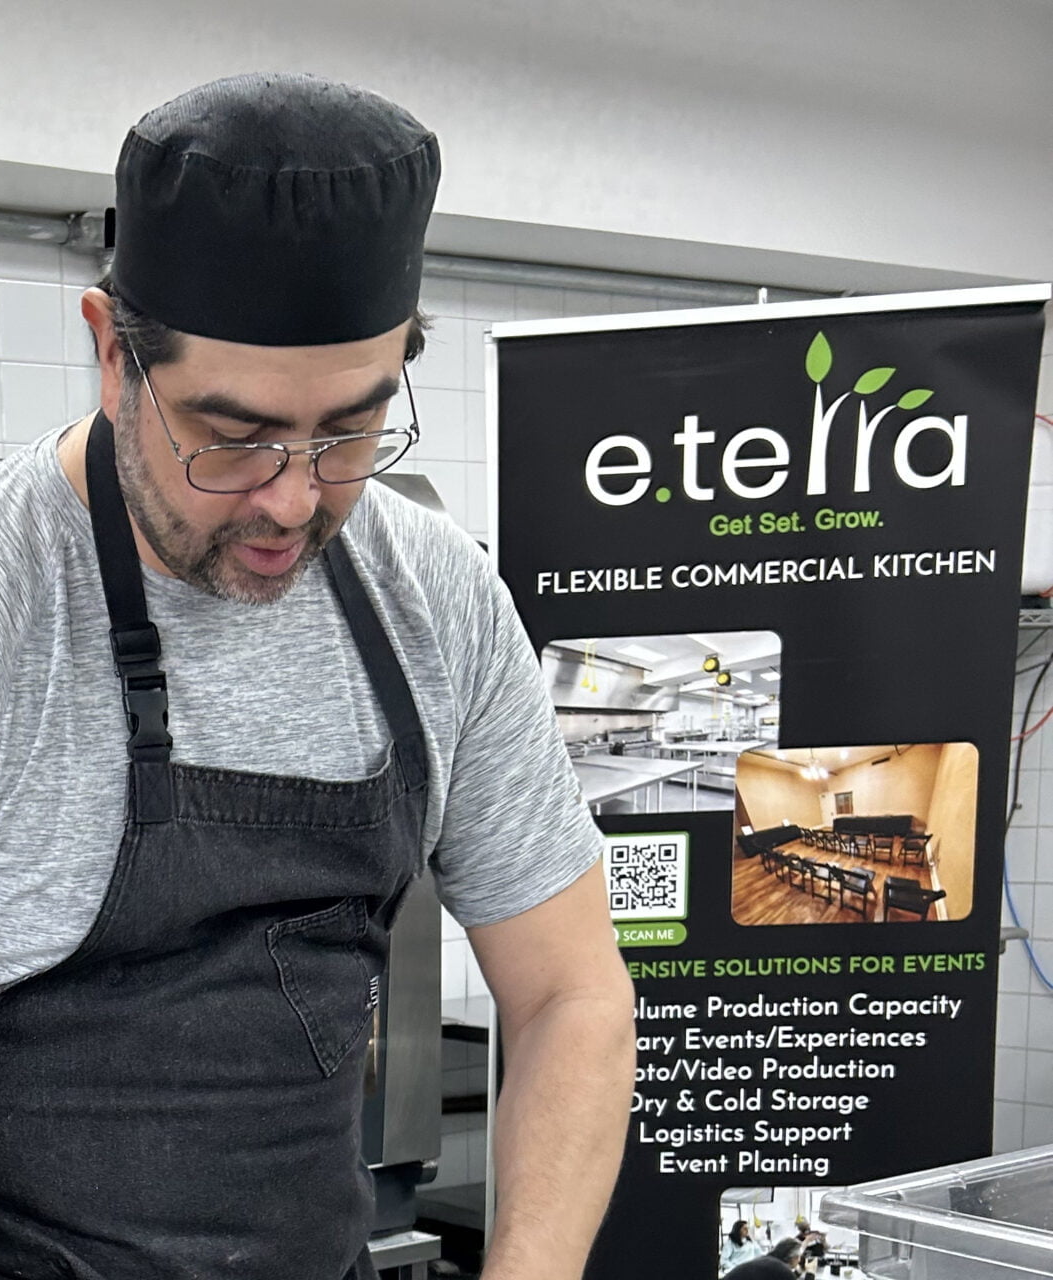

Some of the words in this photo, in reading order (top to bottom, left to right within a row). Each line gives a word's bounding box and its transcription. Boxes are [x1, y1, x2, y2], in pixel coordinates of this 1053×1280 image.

[585, 383, 968, 506] e.terra
[709, 514, 752, 537] Get
[758, 511, 806, 534] Set.
[814, 508, 884, 531] Grow.
[537, 566, 663, 595] FLEXIBLE
[671, 556, 864, 589] COMMERCIAL
[873, 549, 996, 578] KITCHEN
[623, 929, 654, 942] SCAN
[656, 928, 675, 941] ME
[628, 960, 706, 980] ENSIVE
[713, 956, 841, 977] SOLUTIONS
[849, 956, 895, 974] FOR
[903, 952, 986, 973] EVENTS
[633, 996, 698, 1019] lume
[707, 993, 839, 1018] Production
[848, 992, 962, 1020] Capacity
[635, 1036, 676, 1055] ary
[685, 1025, 926, 1053] Events/Experiences
[635, 1057, 753, 1082] oto/Video
[762, 1055, 895, 1080] Production
[631, 1091, 668, 1117] Dry
[676, 1089, 695, 1112] &
[705, 1088, 762, 1112] Cold
[770, 1088, 870, 1115] Storage
[639, 1121, 745, 1148] Logistics
[753, 1119, 853, 1147] Support
[659, 1151, 729, 1174] Event
[738, 1149, 829, 1177] Planing
